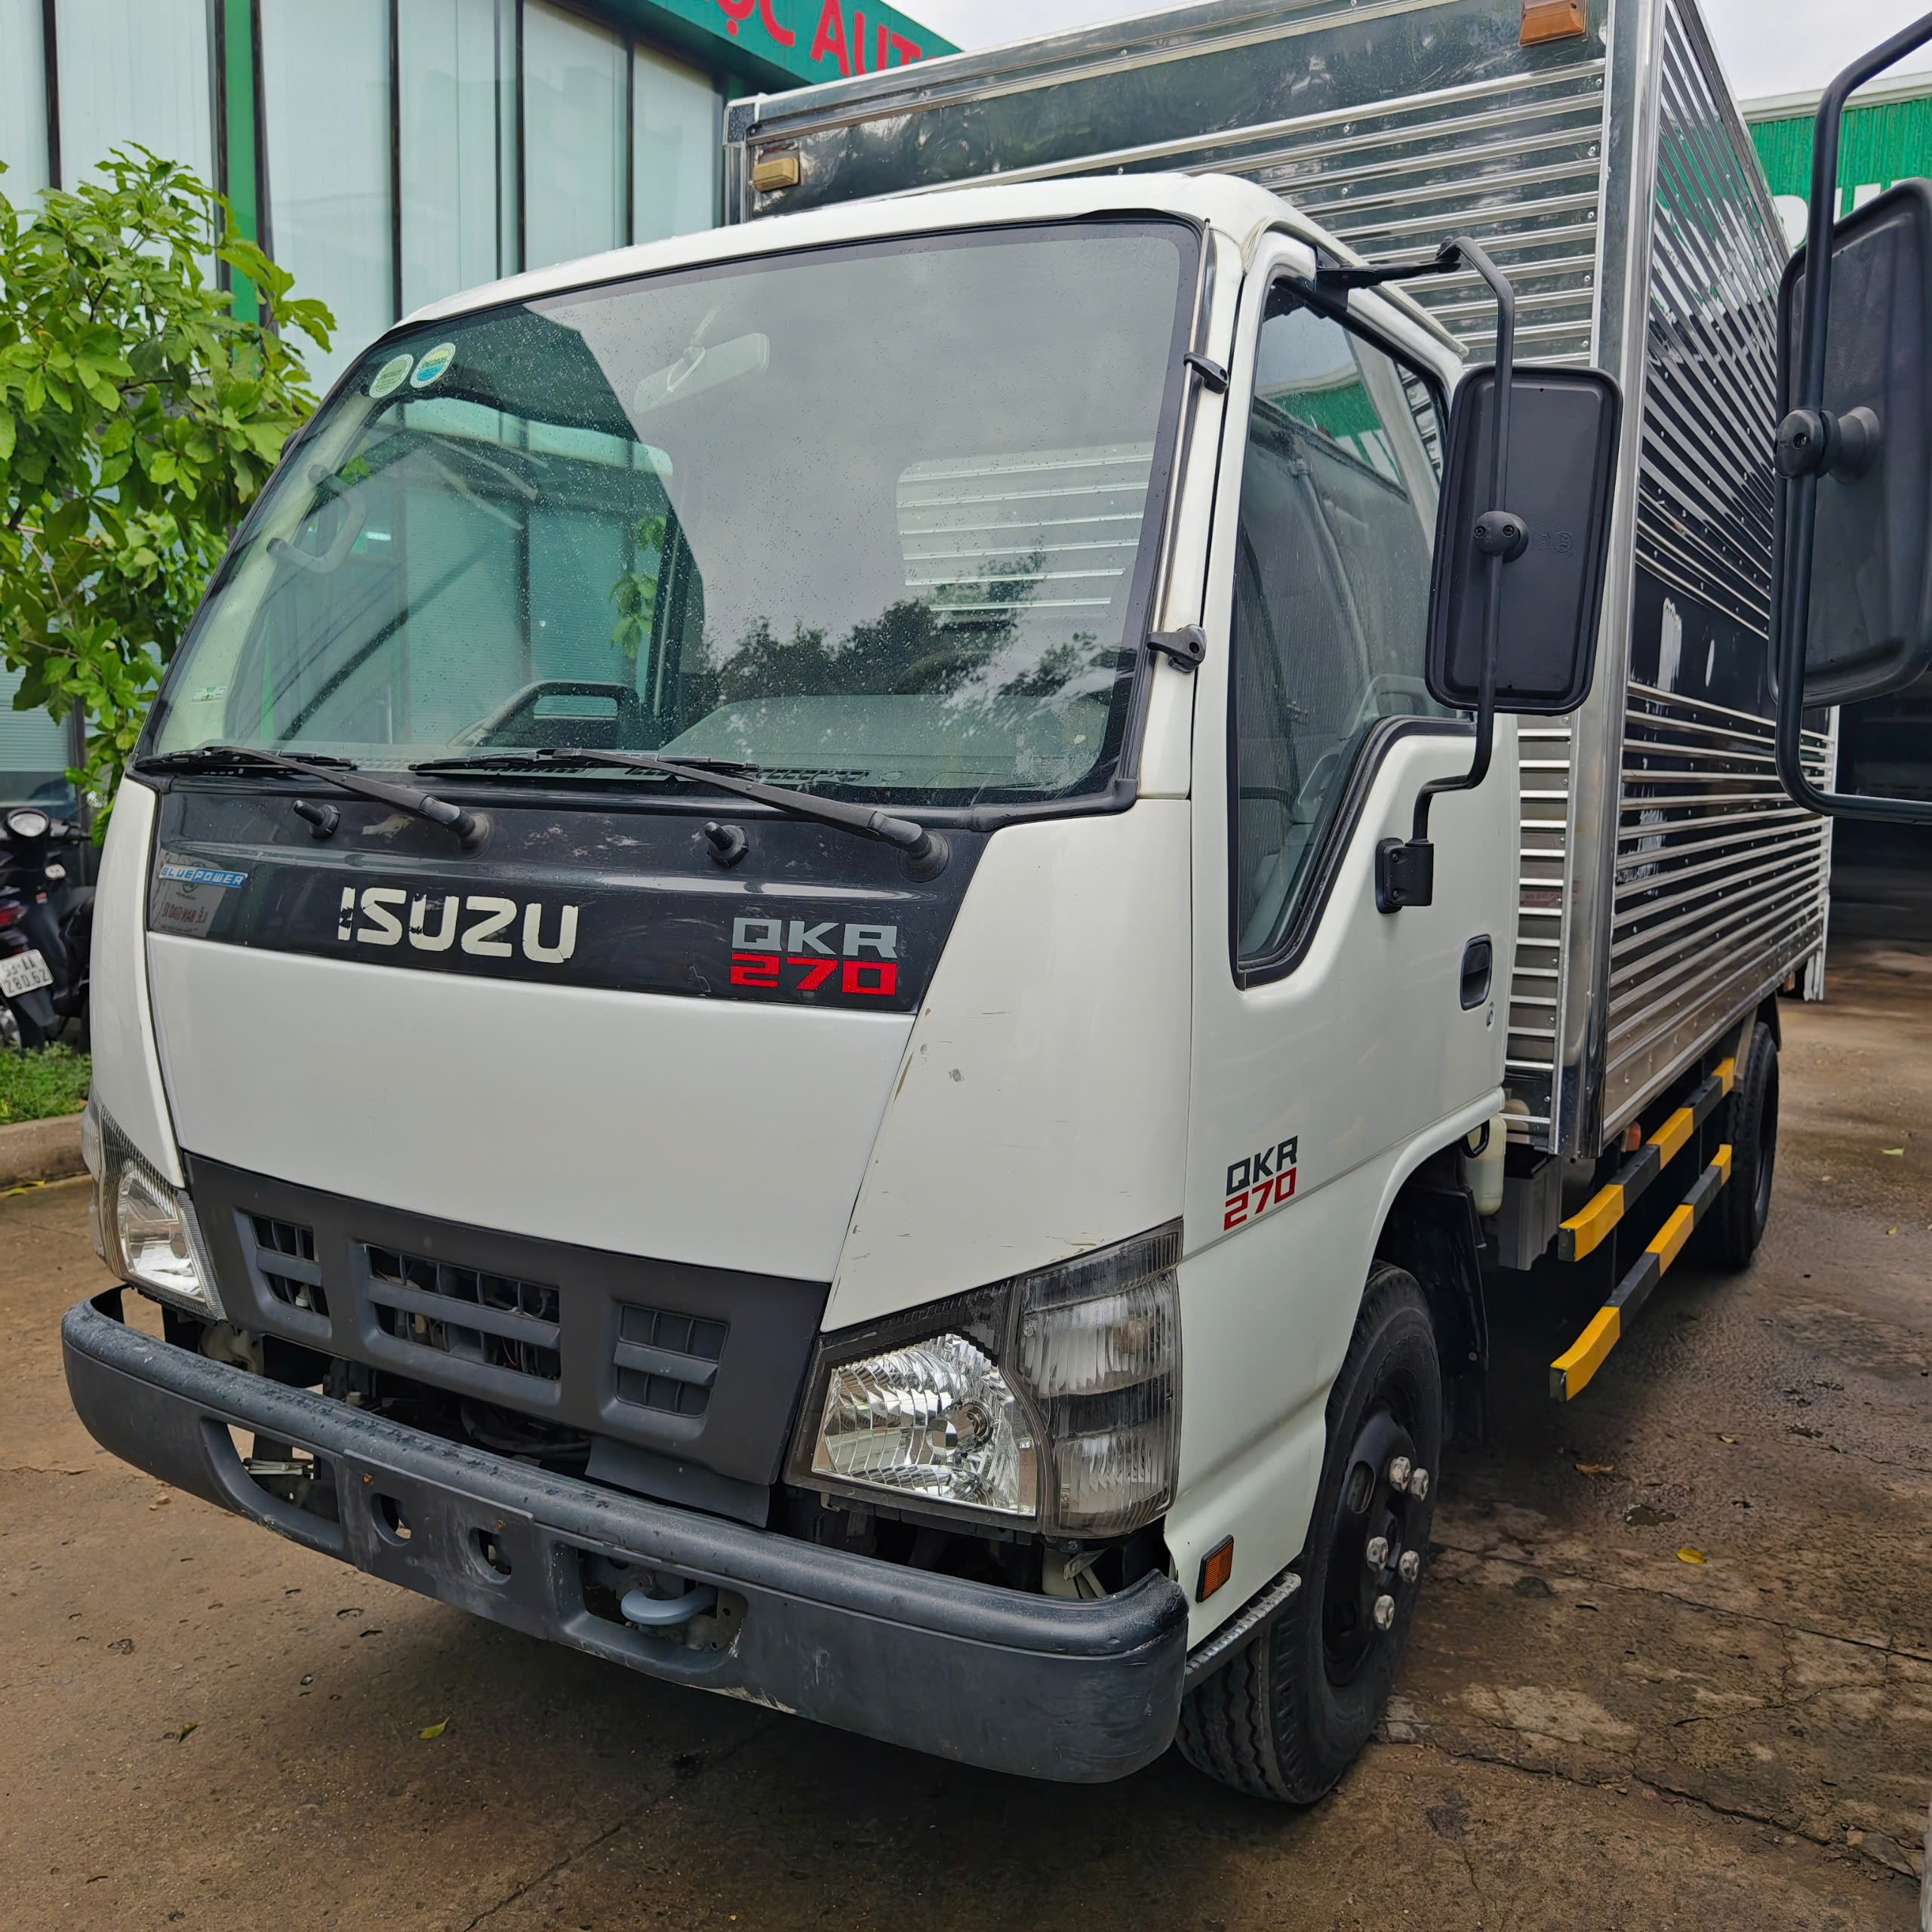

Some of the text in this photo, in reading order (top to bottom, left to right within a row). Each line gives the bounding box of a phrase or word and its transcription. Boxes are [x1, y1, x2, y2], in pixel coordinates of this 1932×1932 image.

[810, 0, 937, 78] AUT
[162, 867, 245, 886] BLUEPOWER
[337, 886, 579, 964] ISUZU
[731, 917, 898, 958] QKR
[730, 952, 898, 996] 270
[1226, 1135, 1299, 1197] QKR
[1223, 1166, 1297, 1232] 270
